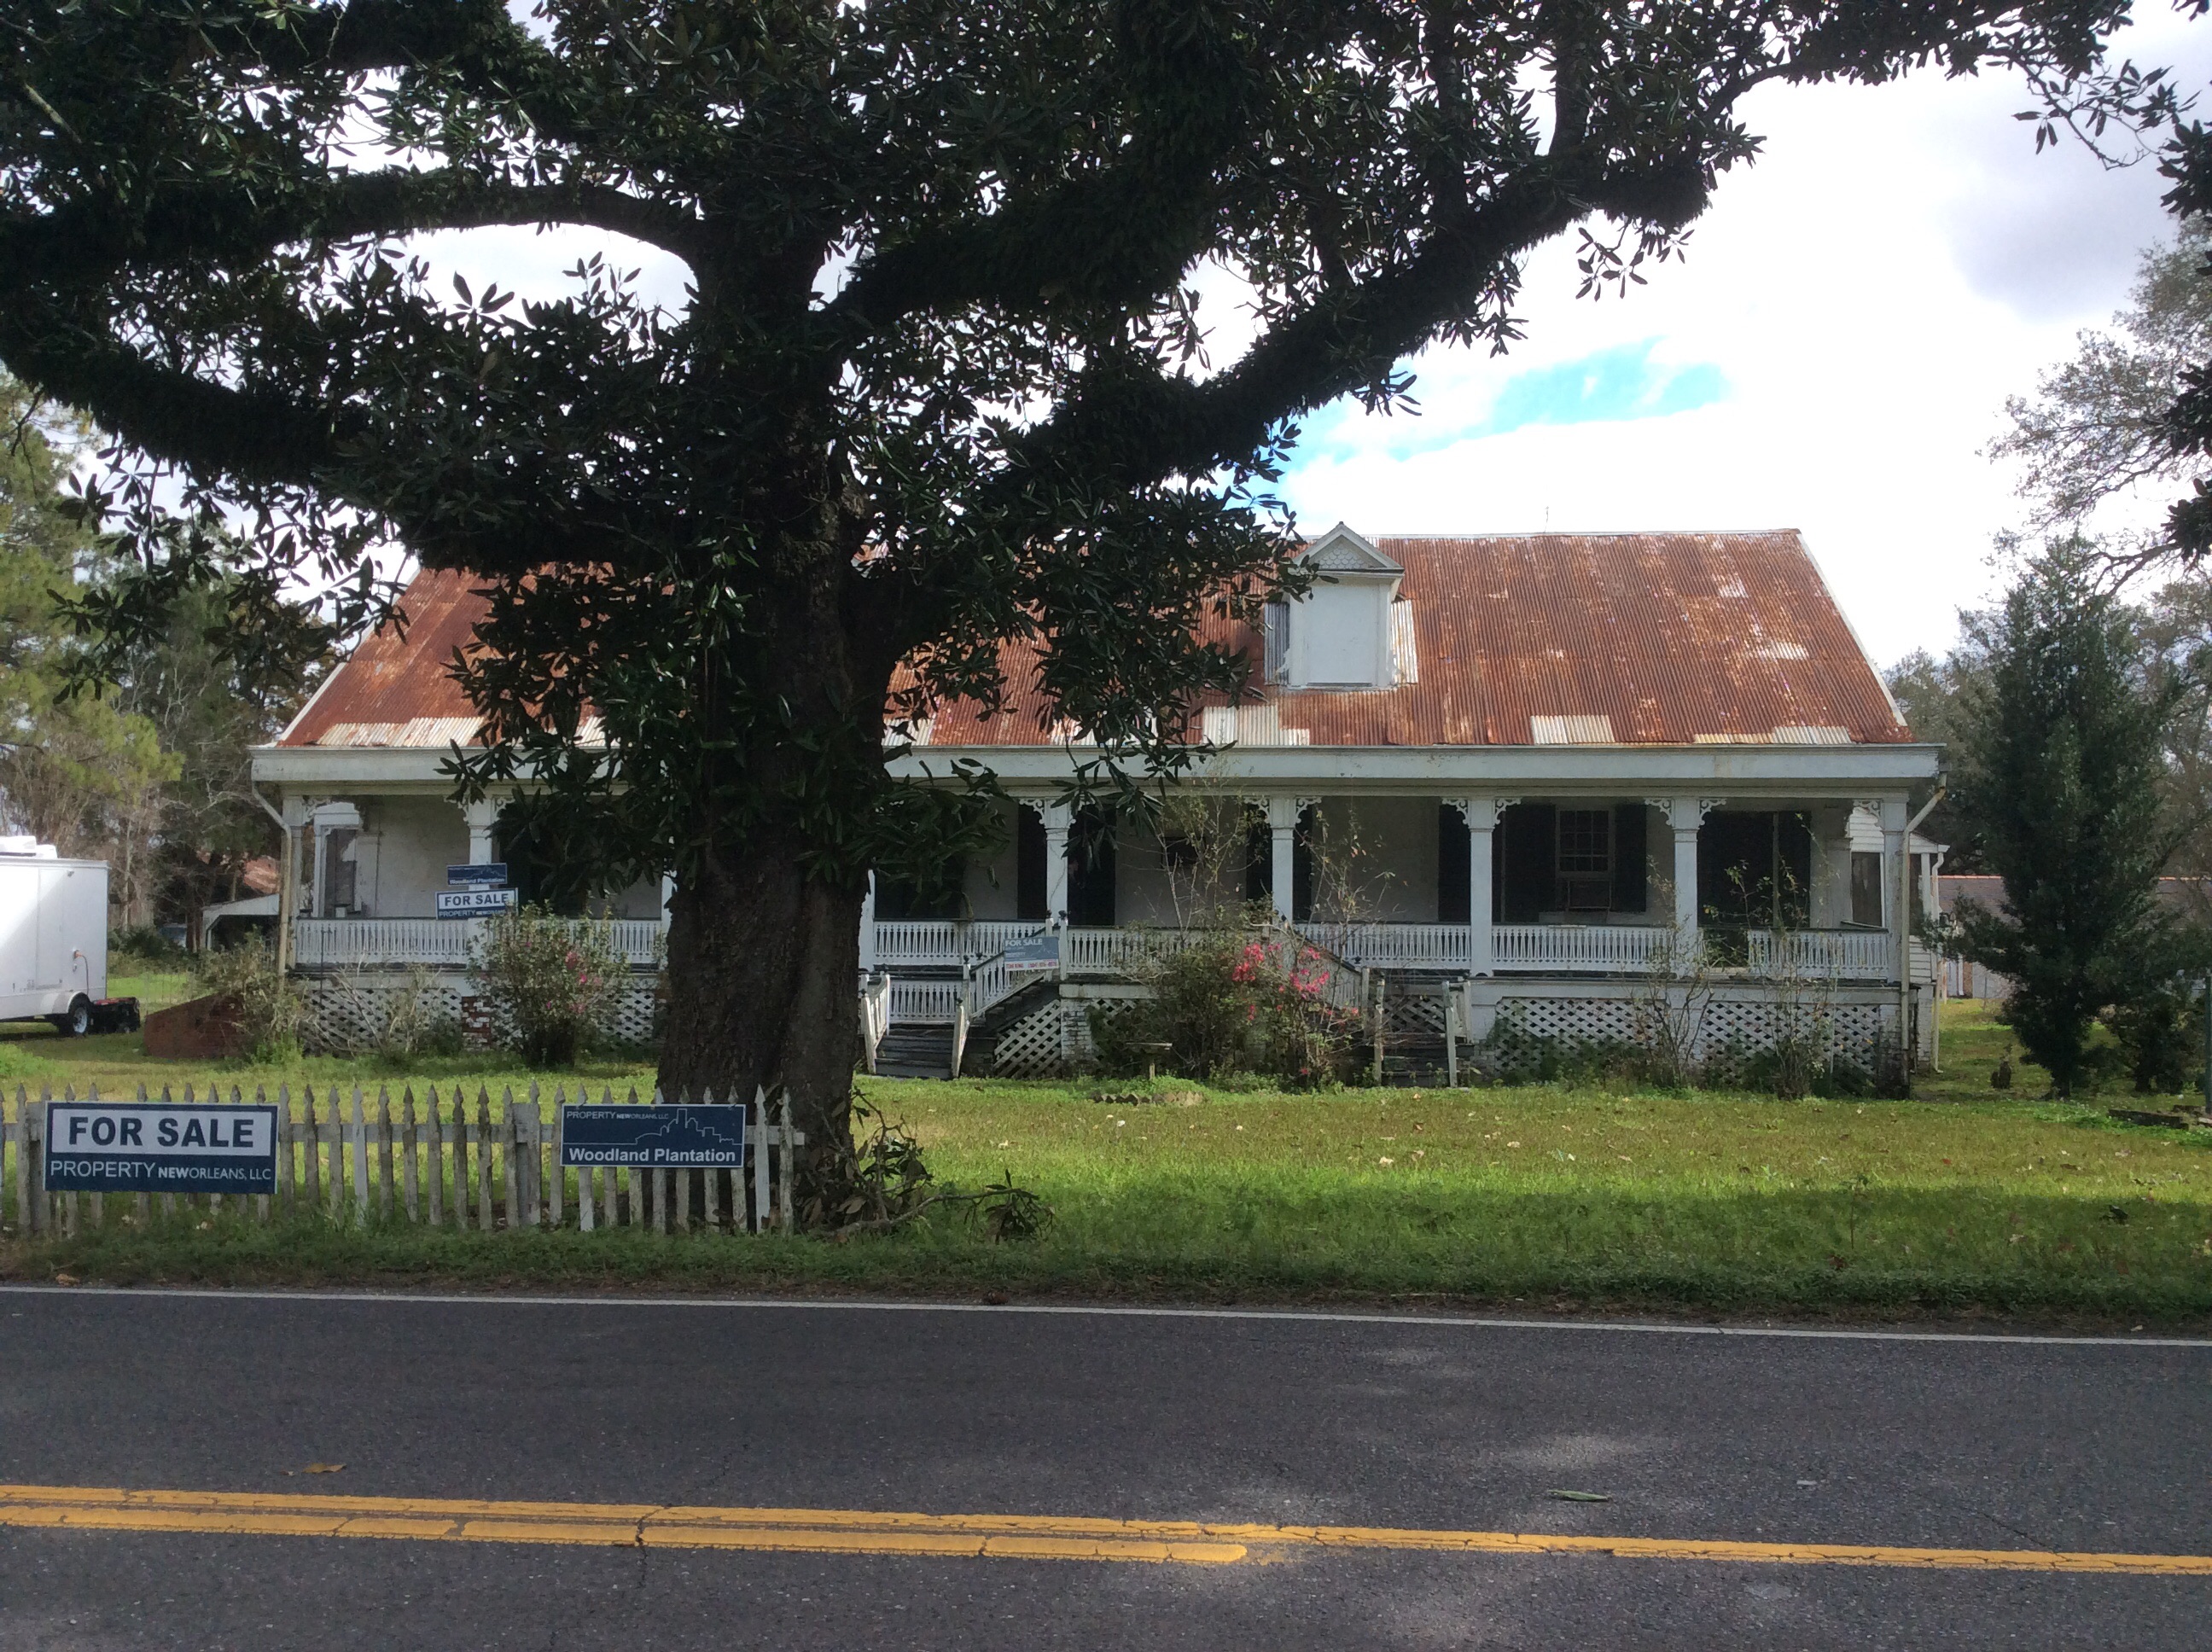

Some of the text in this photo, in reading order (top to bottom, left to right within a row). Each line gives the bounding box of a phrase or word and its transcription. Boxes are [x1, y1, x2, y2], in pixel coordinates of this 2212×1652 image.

[445, 893, 508, 906] FOR SALE
[566, 1111, 616, 1120] PROPERTY
[69, 1116, 254, 1148] FOR SALE
[569, 1147, 736, 1162] Woodland Plantation
[50, 1160, 156, 1178] PROPERTY
[249, 1168, 271, 1180] LLC
